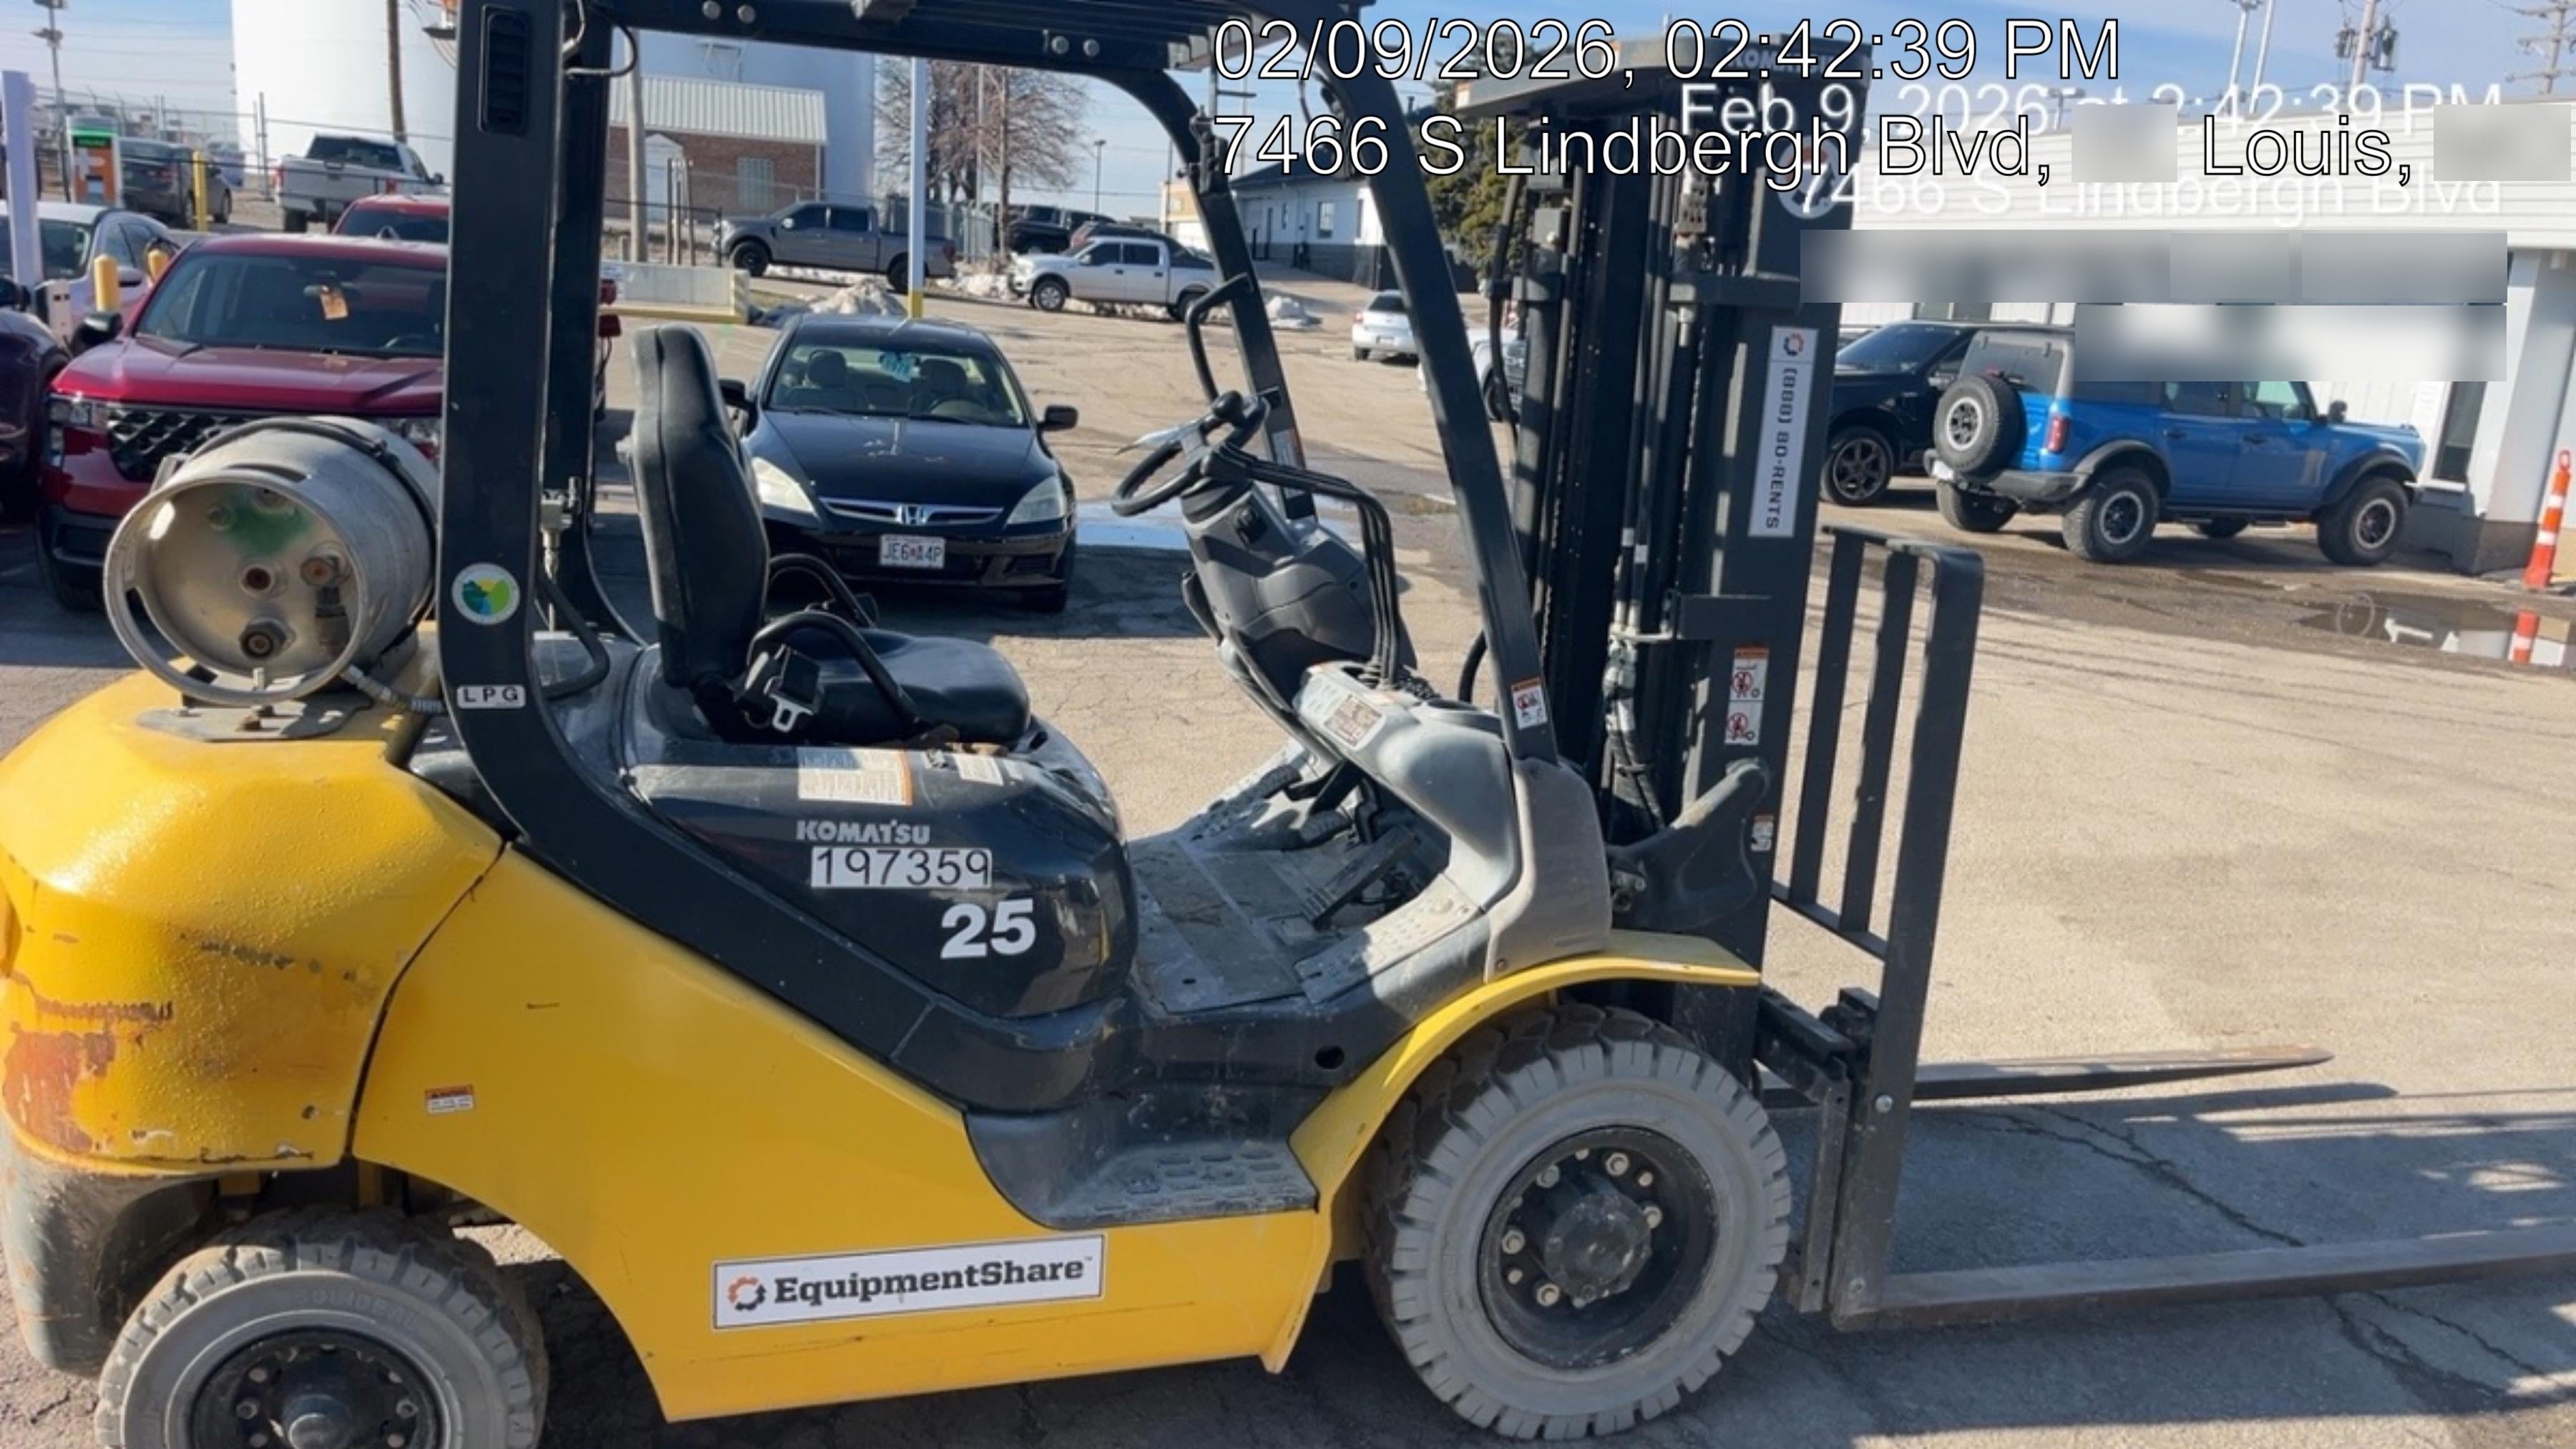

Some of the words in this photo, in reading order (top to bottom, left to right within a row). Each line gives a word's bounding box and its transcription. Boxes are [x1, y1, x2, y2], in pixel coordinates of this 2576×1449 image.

[1777, 367, 1798, 424] (888)
[1765, 431, 1790, 530] 80-RENTS
[463, 686, 519, 703] LPG
[796, 819, 930, 844] KOMATSU
[816, 849, 989, 886] 197359
[940, 899, 1036, 960] 25
[774, 1259, 1085, 1306] EquipmentShare
